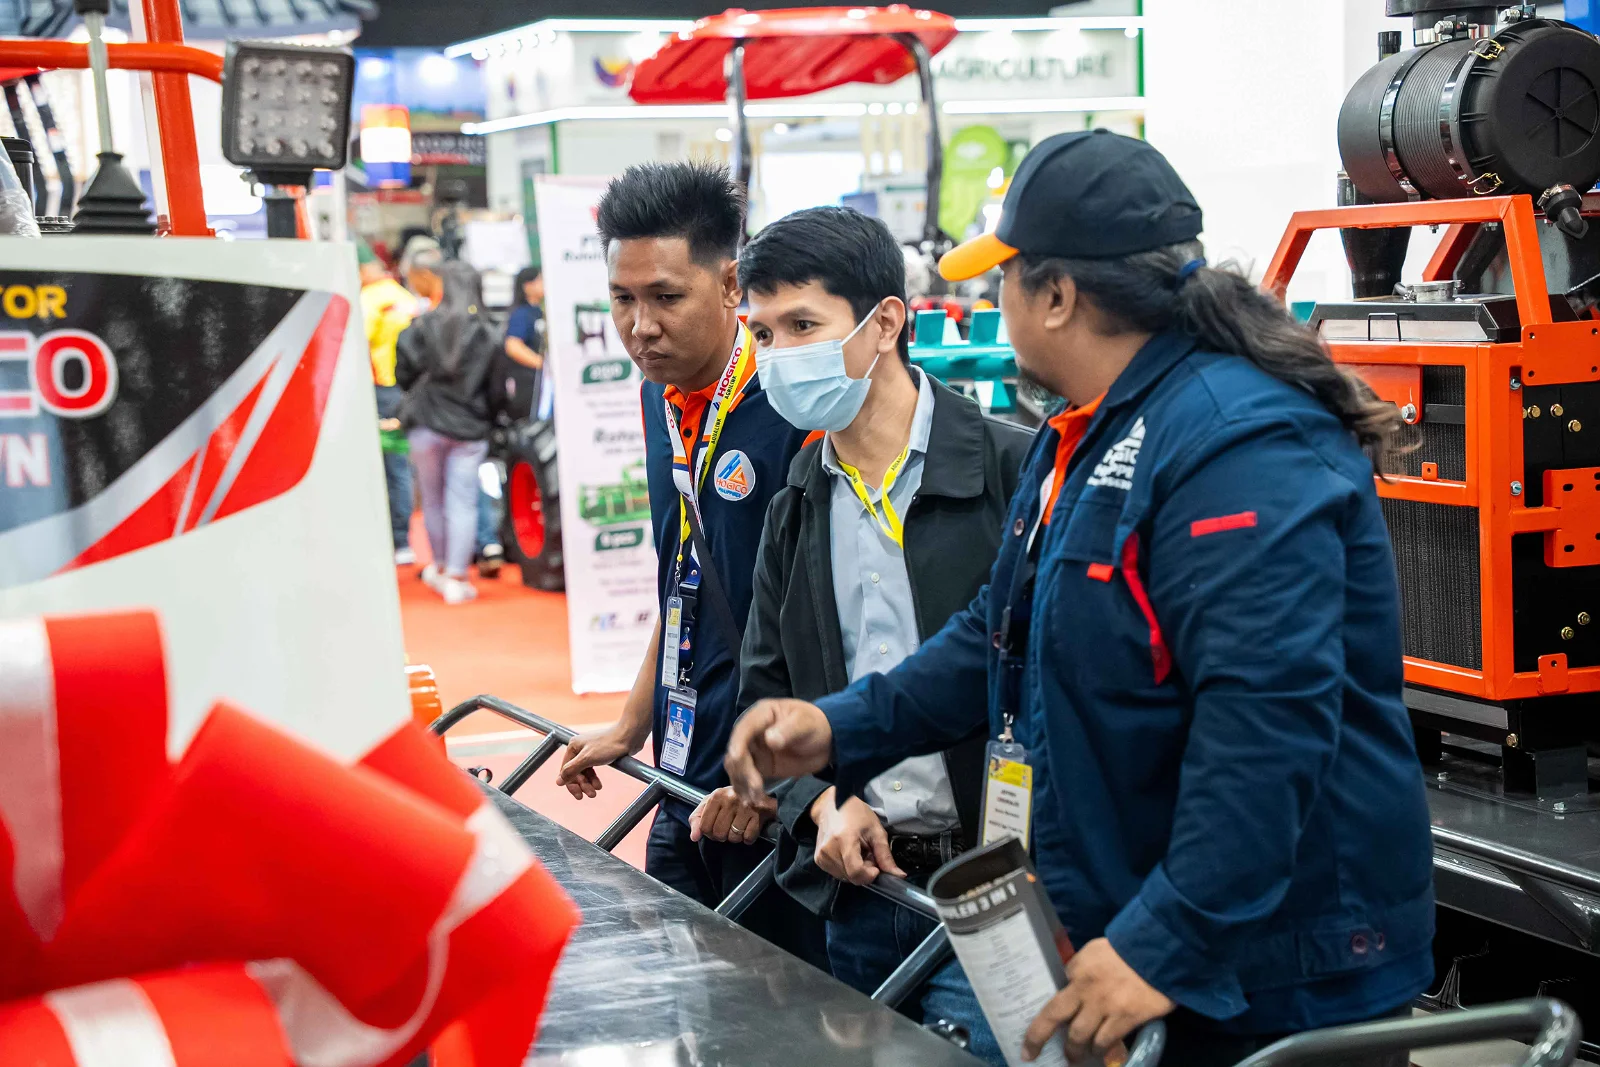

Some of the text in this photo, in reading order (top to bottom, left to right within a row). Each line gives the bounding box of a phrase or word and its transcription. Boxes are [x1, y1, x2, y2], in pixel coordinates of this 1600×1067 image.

[0, 284, 68, 319] OR
[717, 346, 743, 398] HOGICO
[711, 417, 722, 445] AQUALINK
[716, 478, 748, 495] HOGICO
